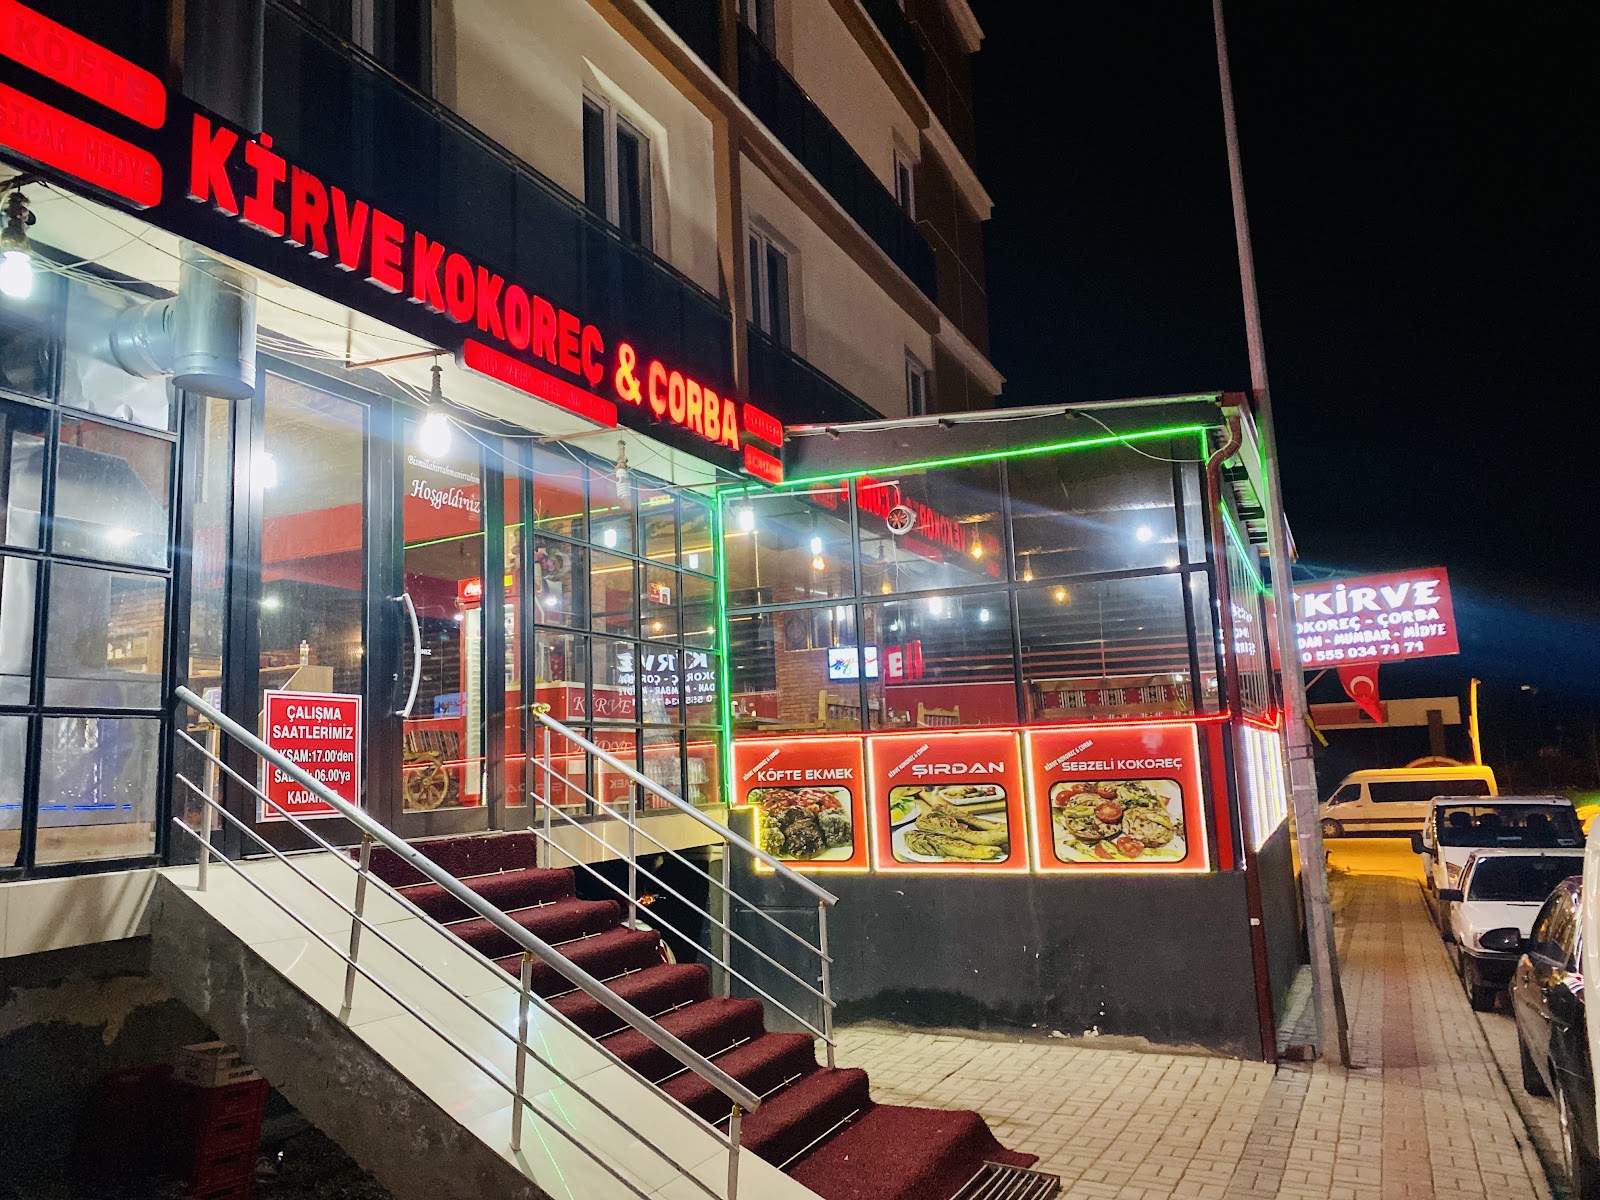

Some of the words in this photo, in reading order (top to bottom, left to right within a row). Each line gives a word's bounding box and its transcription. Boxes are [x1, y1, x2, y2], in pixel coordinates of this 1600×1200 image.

[14, 16, 149, 112] KÖFTE
[191, 113, 404, 292] KİRVE
[414, 230, 604, 388] KOKOREÇ
[615, 342, 642, 405] &
[649, 359, 740, 451] ÇORBA
[410, 479, 480, 513] Hoşgeldiniz
[1304, 579, 1441, 617] KİRVE
[1296, 616, 1361, 635] OKOREÇ
[1377, 607, 1440, 628] ÇORBA
[1298, 635, 1322, 650] DAN
[1334, 628, 1391, 646] MUMBAR
[1403, 622, 1447, 638] MİDYE
[1302, 652, 1312, 662] 0
[1316, 649, 1344, 661] 555
[1348, 646, 1377, 658] 034
[1380, 643, 1400, 655] 71
[1404, 640, 1424, 652] 71
[286, 705, 342, 723] ÇALIŞMA
[272, 723, 354, 739] SAATLERİMİZ
[757, 768, 802, 781] KÖFTE
[805, 768, 853, 779] EKMEK
[911, 761, 1004, 778] ŞIRDAN
[1061, 758, 1114, 771] SEBZELİ
[1117, 757, 1182, 771] KOKOREÇ
[314, 768, 350, 784] 06.00'ya
